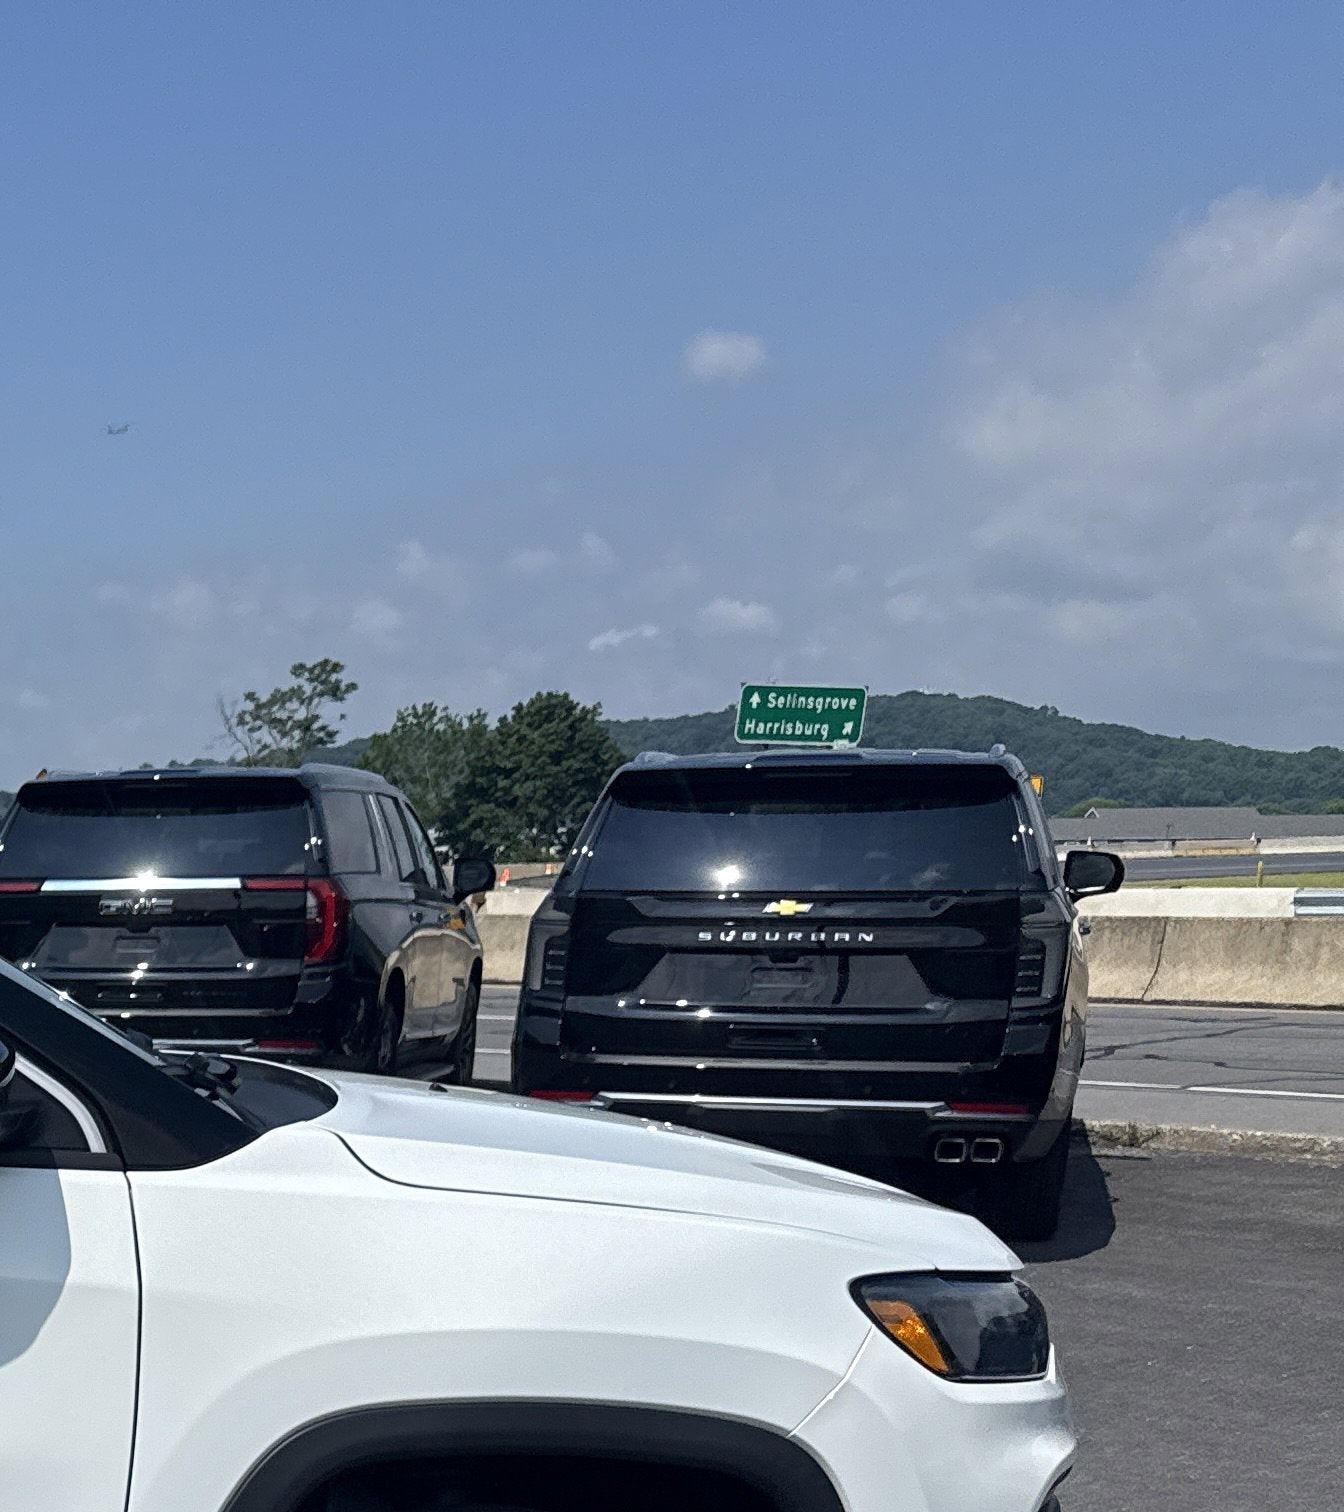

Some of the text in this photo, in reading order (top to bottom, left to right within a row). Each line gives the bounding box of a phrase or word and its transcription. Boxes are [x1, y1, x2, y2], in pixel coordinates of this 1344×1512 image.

[767, 692, 858, 713] Selinsgrove
[744, 719, 830, 741] Harrisburg
[697, 930, 874, 942] SUBURBAN
